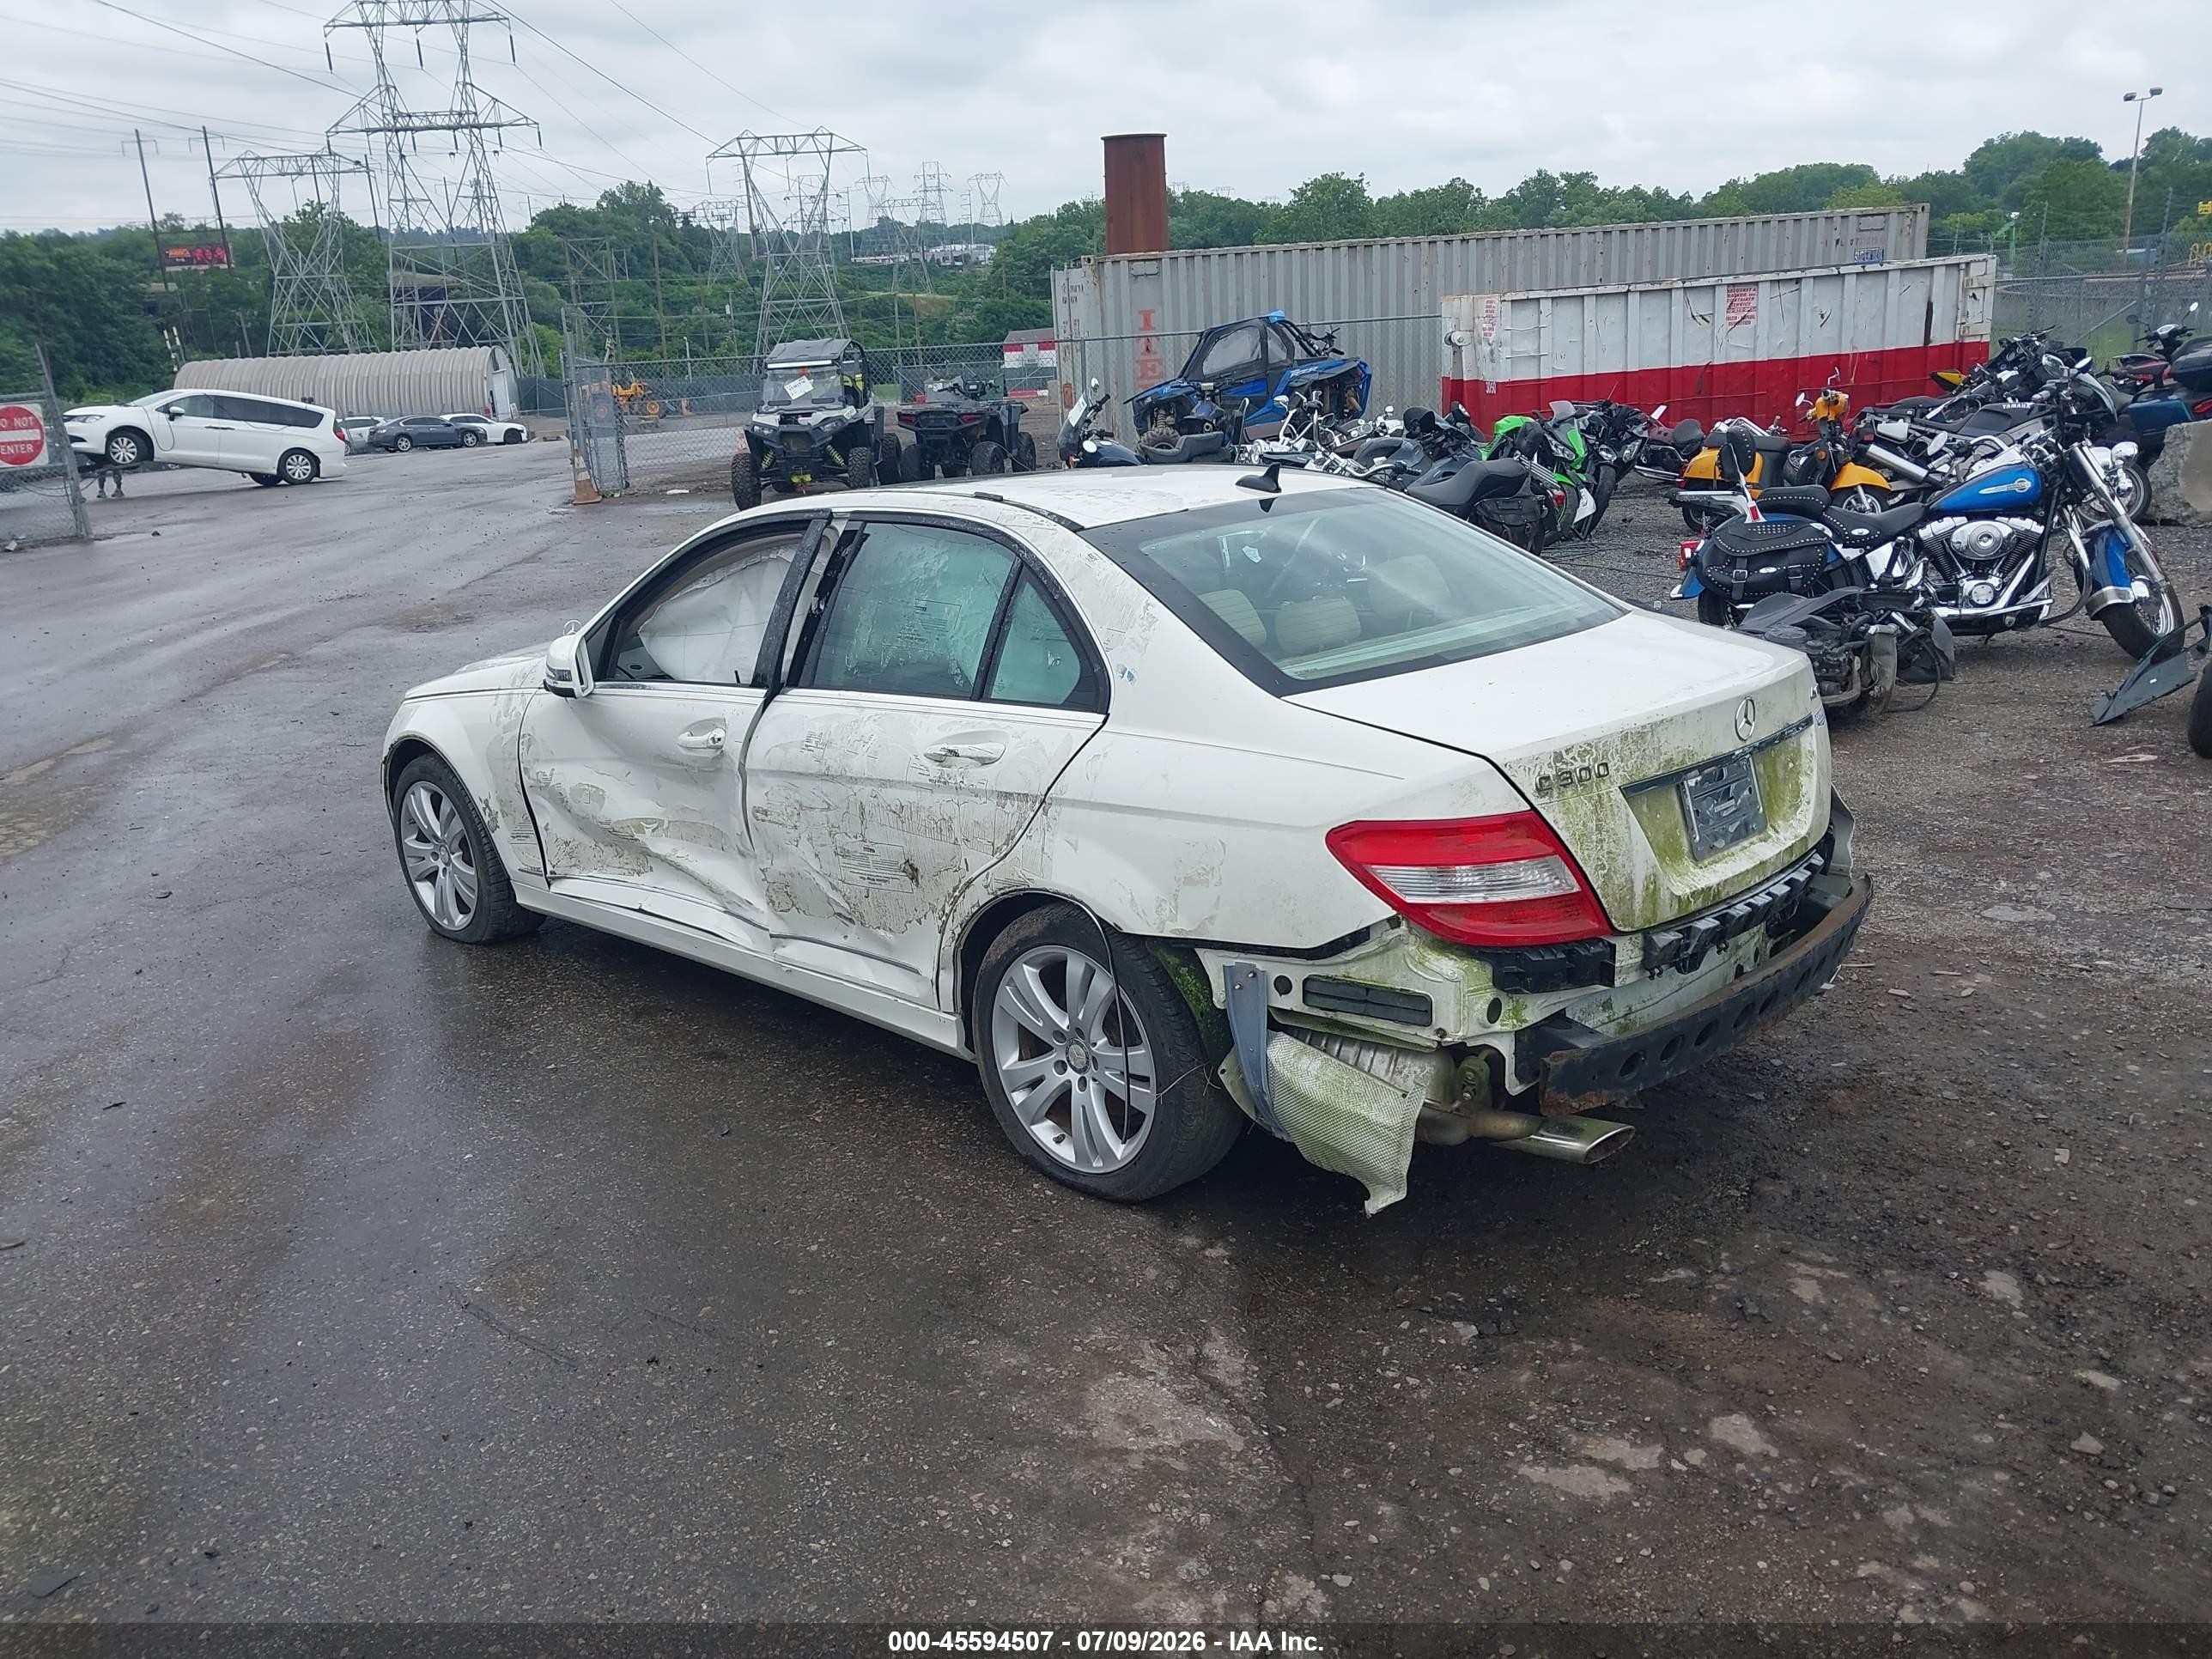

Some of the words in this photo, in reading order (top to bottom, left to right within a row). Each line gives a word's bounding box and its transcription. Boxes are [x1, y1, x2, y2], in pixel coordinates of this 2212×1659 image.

[14, 416, 33, 428] NOT
[1, 443, 33, 454] ENTER
[1558, 762, 1610, 787] 300
